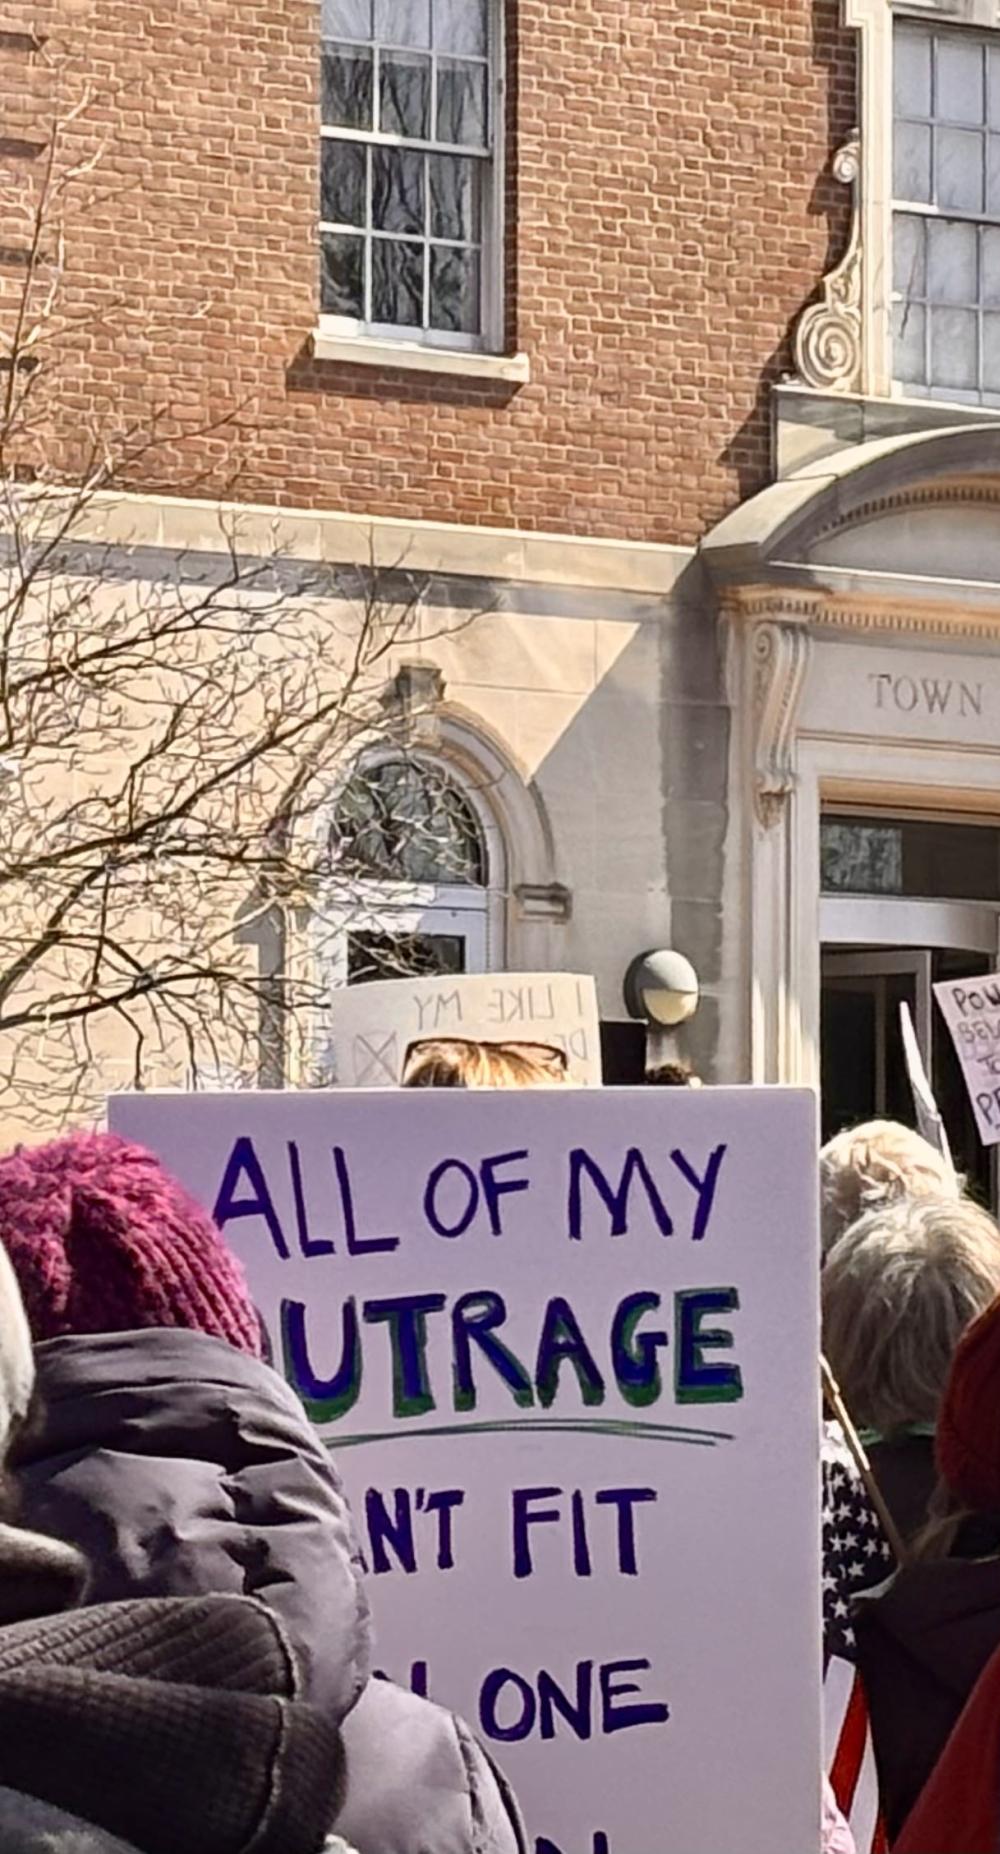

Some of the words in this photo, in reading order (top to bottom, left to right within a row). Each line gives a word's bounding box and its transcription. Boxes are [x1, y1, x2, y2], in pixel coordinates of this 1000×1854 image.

[868, 673, 983, 717] TOWN
[212, 1137, 399, 1260] ALL
[424, 1150, 530, 1239] OF
[567, 1144, 727, 1241] MY
[252, 1286, 744, 1424] UTRAGE
[511, 1487, 658, 1578] FIT
[479, 1659, 670, 1743] ONE
